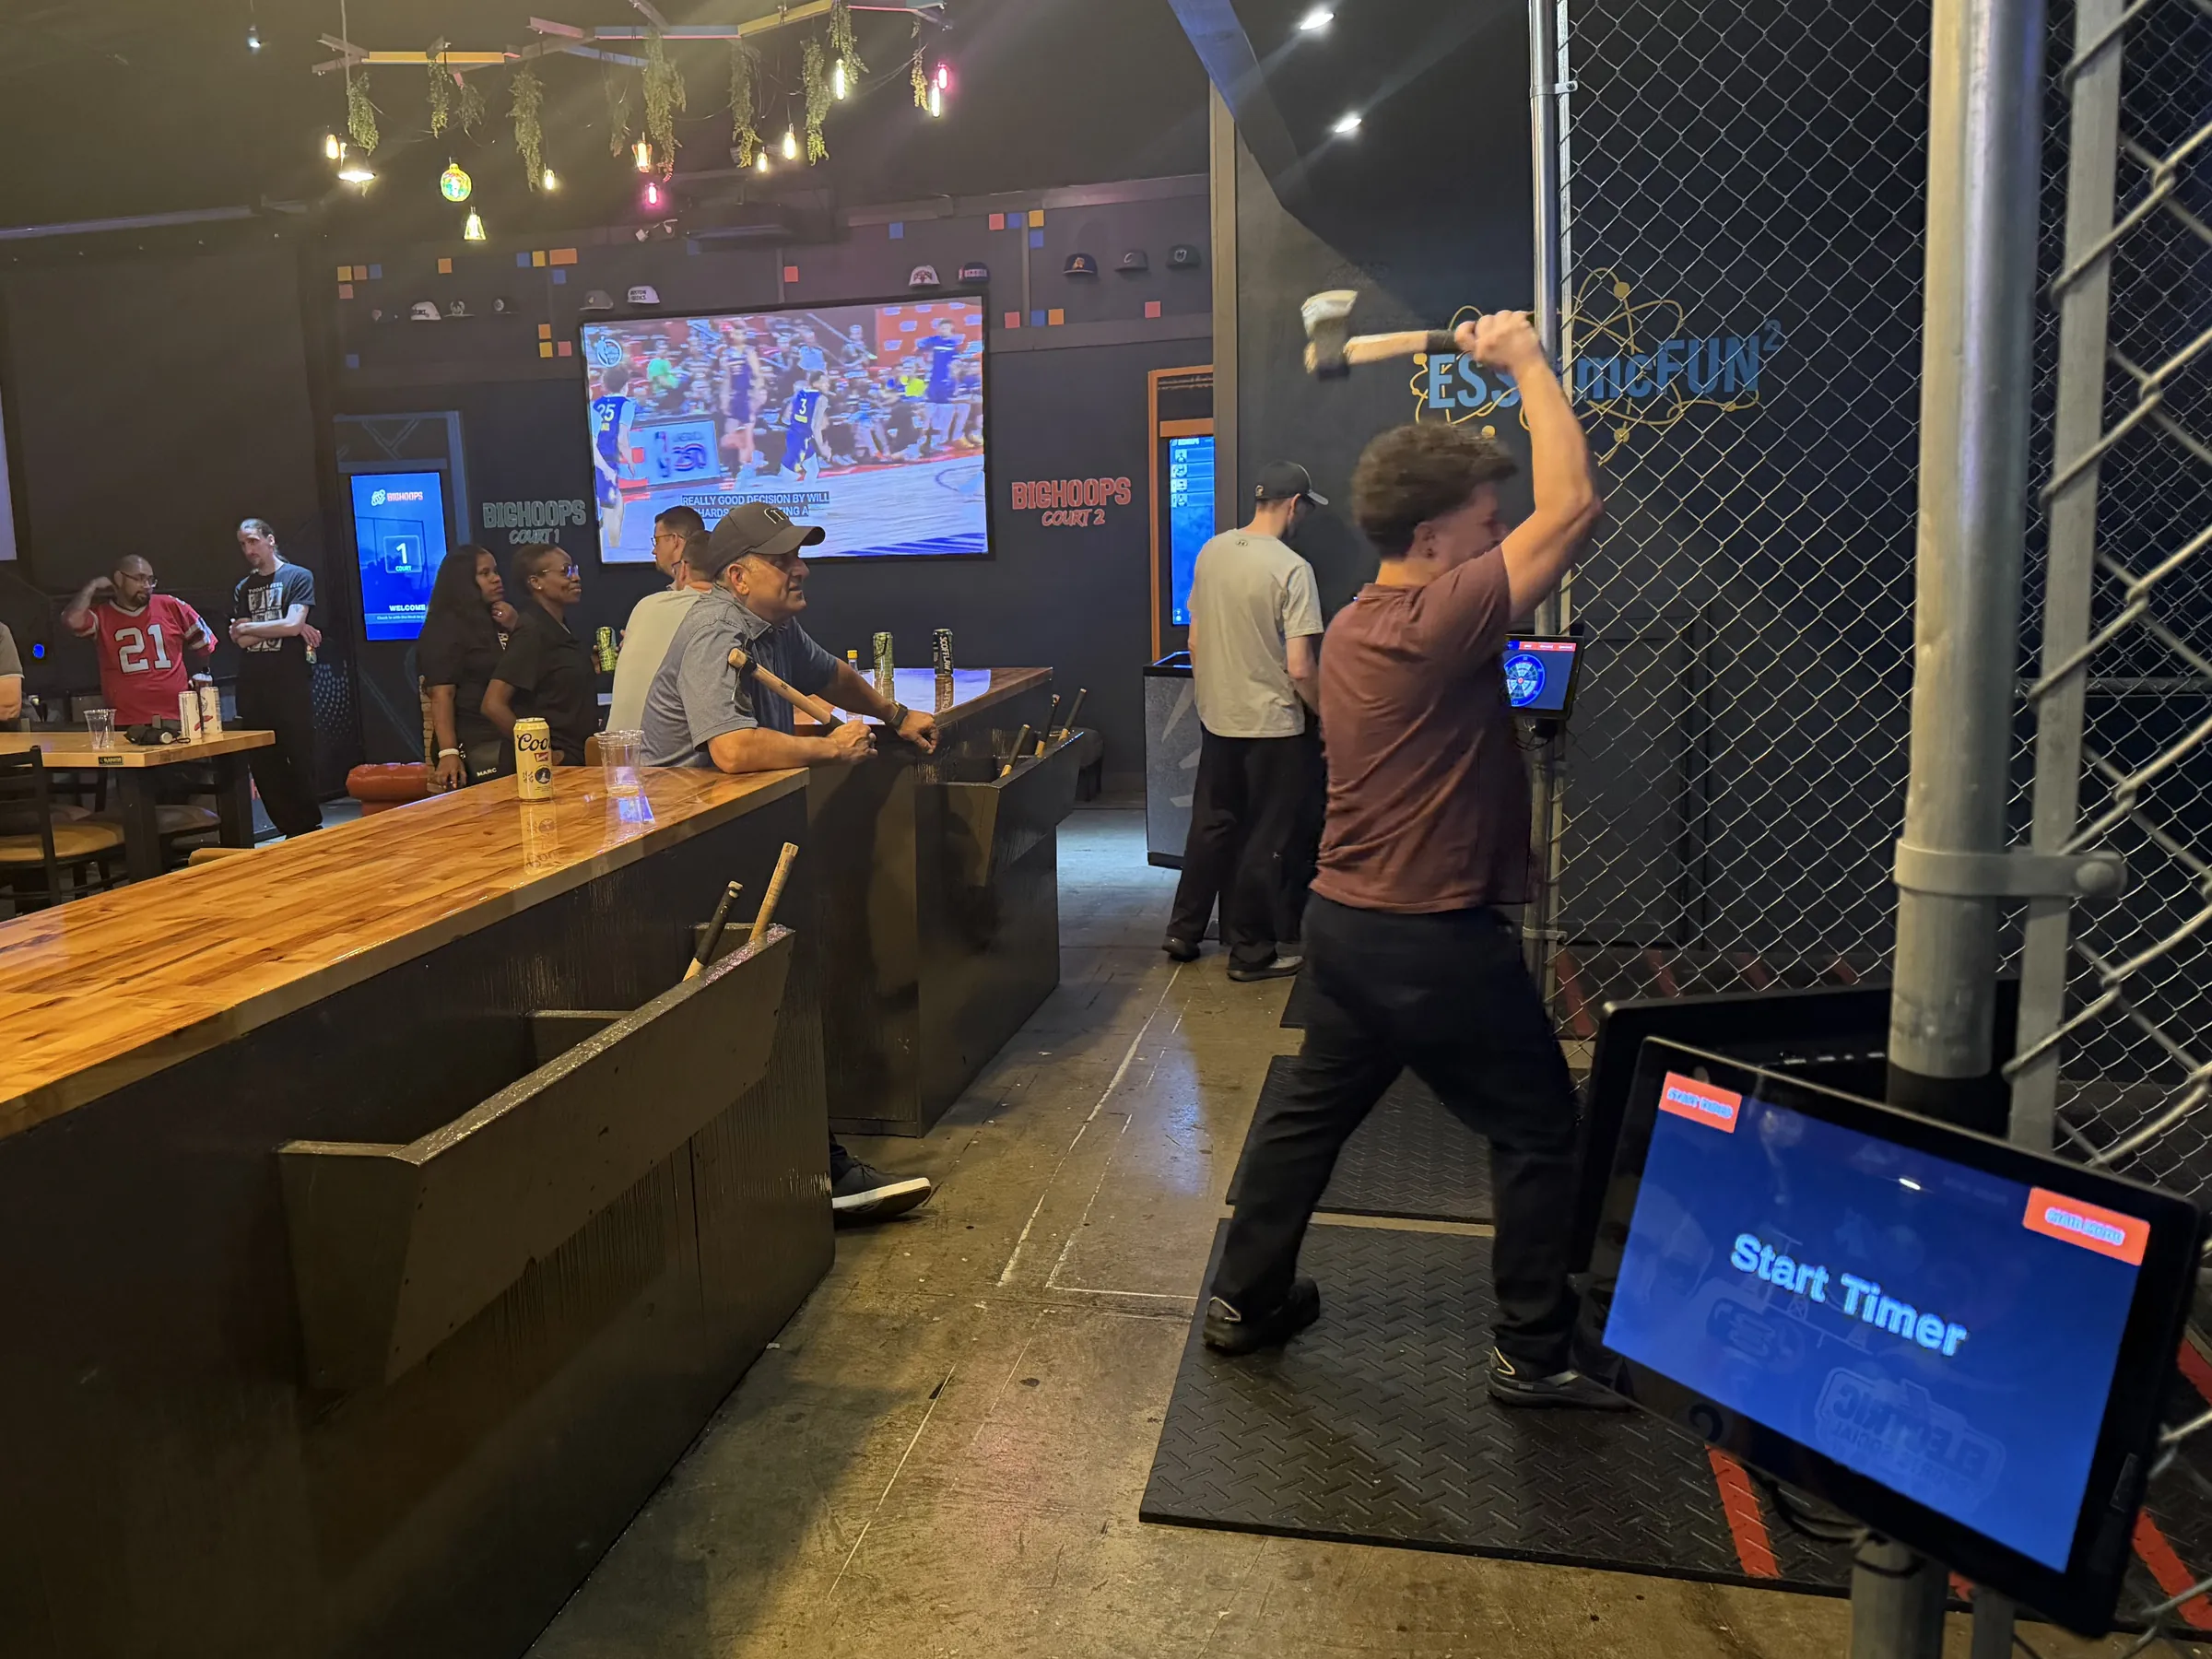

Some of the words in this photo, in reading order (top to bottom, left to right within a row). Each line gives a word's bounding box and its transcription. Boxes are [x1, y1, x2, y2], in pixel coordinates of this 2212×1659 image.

[596, 403, 617, 422] 25
[798, 397, 808, 416] 3
[683, 496, 716, 506] REALLY
[717, 495, 745, 505] GOOD
[747, 494, 791, 504] DECISION
[793, 493, 805, 503] BY
[806, 492, 830, 502] WILL
[1011, 477, 1132, 510] BIGHOOPS
[482, 499, 587, 528] BIGHOOPS
[1041, 509, 1093, 527] COURT
[1093, 508, 1106, 525] 2
[508, 528, 553, 545] COURT
[553, 528, 560, 544] 1
[395, 542, 408, 564] 1
[388, 604, 426, 612] WELCOME
[113, 623, 172, 674] 21
[939, 635, 952, 672] SCOFFLAW
[516, 733, 551, 752] Coo
[477, 767, 498, 777] MARC
[1730, 1233, 1830, 1302] Start
[1840, 1272, 1969, 1357] Timer
